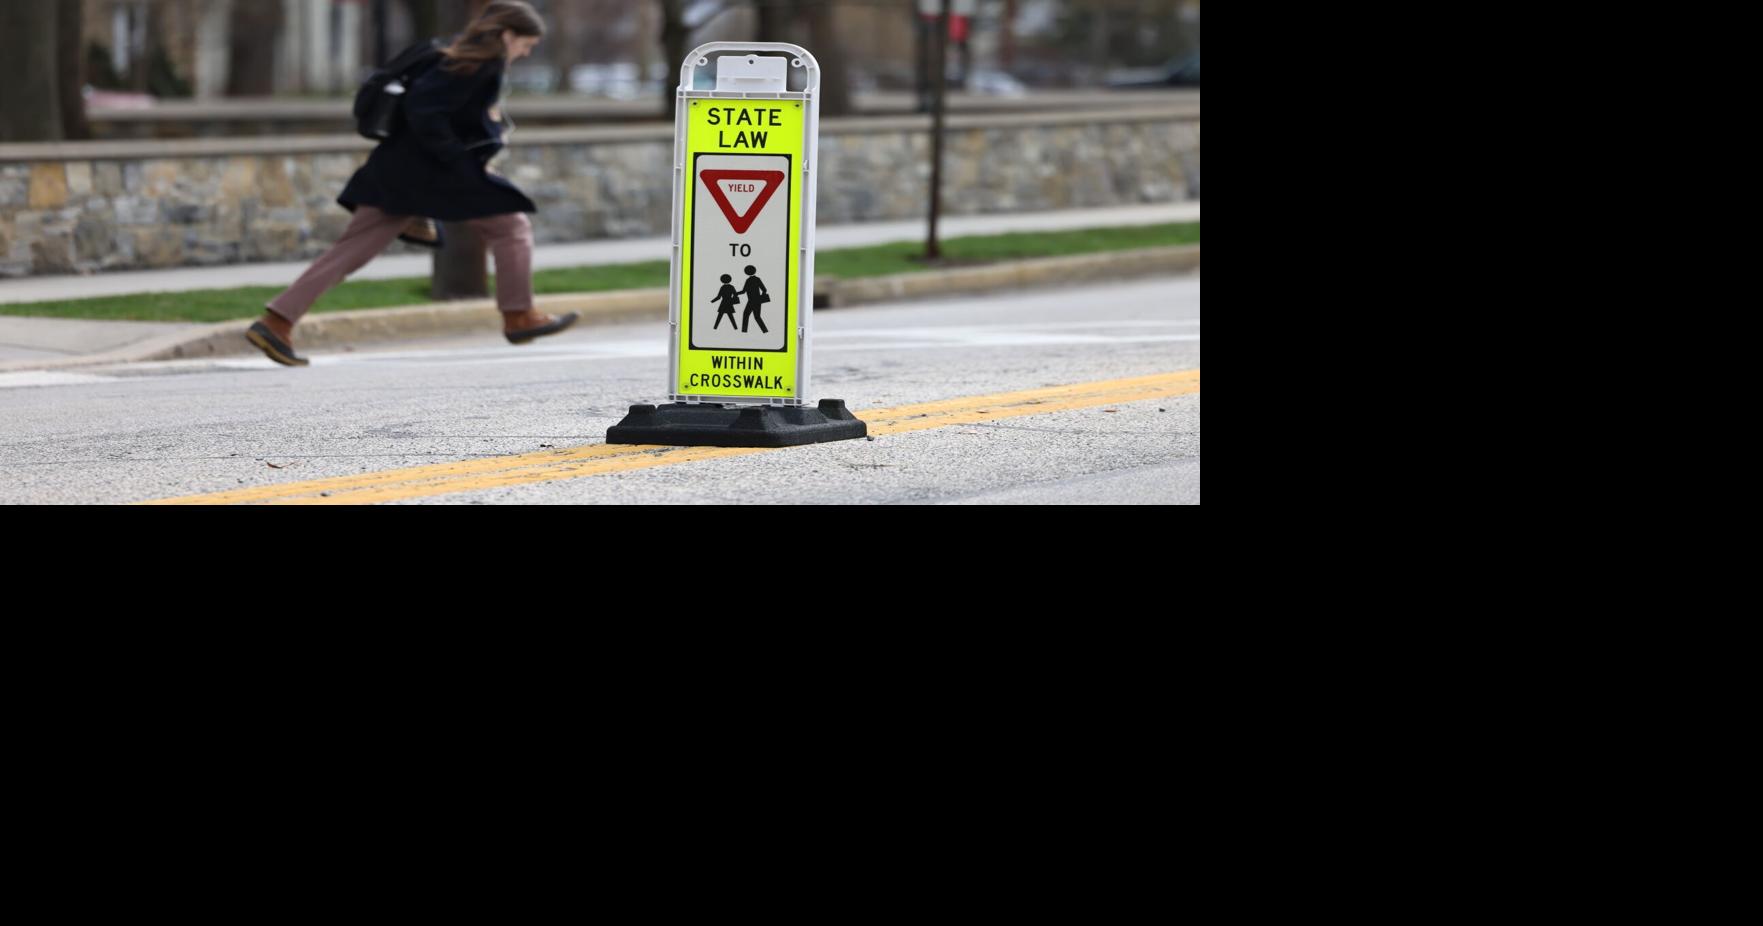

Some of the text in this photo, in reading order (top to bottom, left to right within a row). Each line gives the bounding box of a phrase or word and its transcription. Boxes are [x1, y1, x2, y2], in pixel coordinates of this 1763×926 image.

[707, 107, 782, 127] STATE
[718, 130, 768, 149] LAW
[727, 183, 755, 193] YIELD
[729, 243, 751, 257] TO
[711, 355, 763, 371] WITHIN
[690, 373, 783, 390] CROSSWALK
